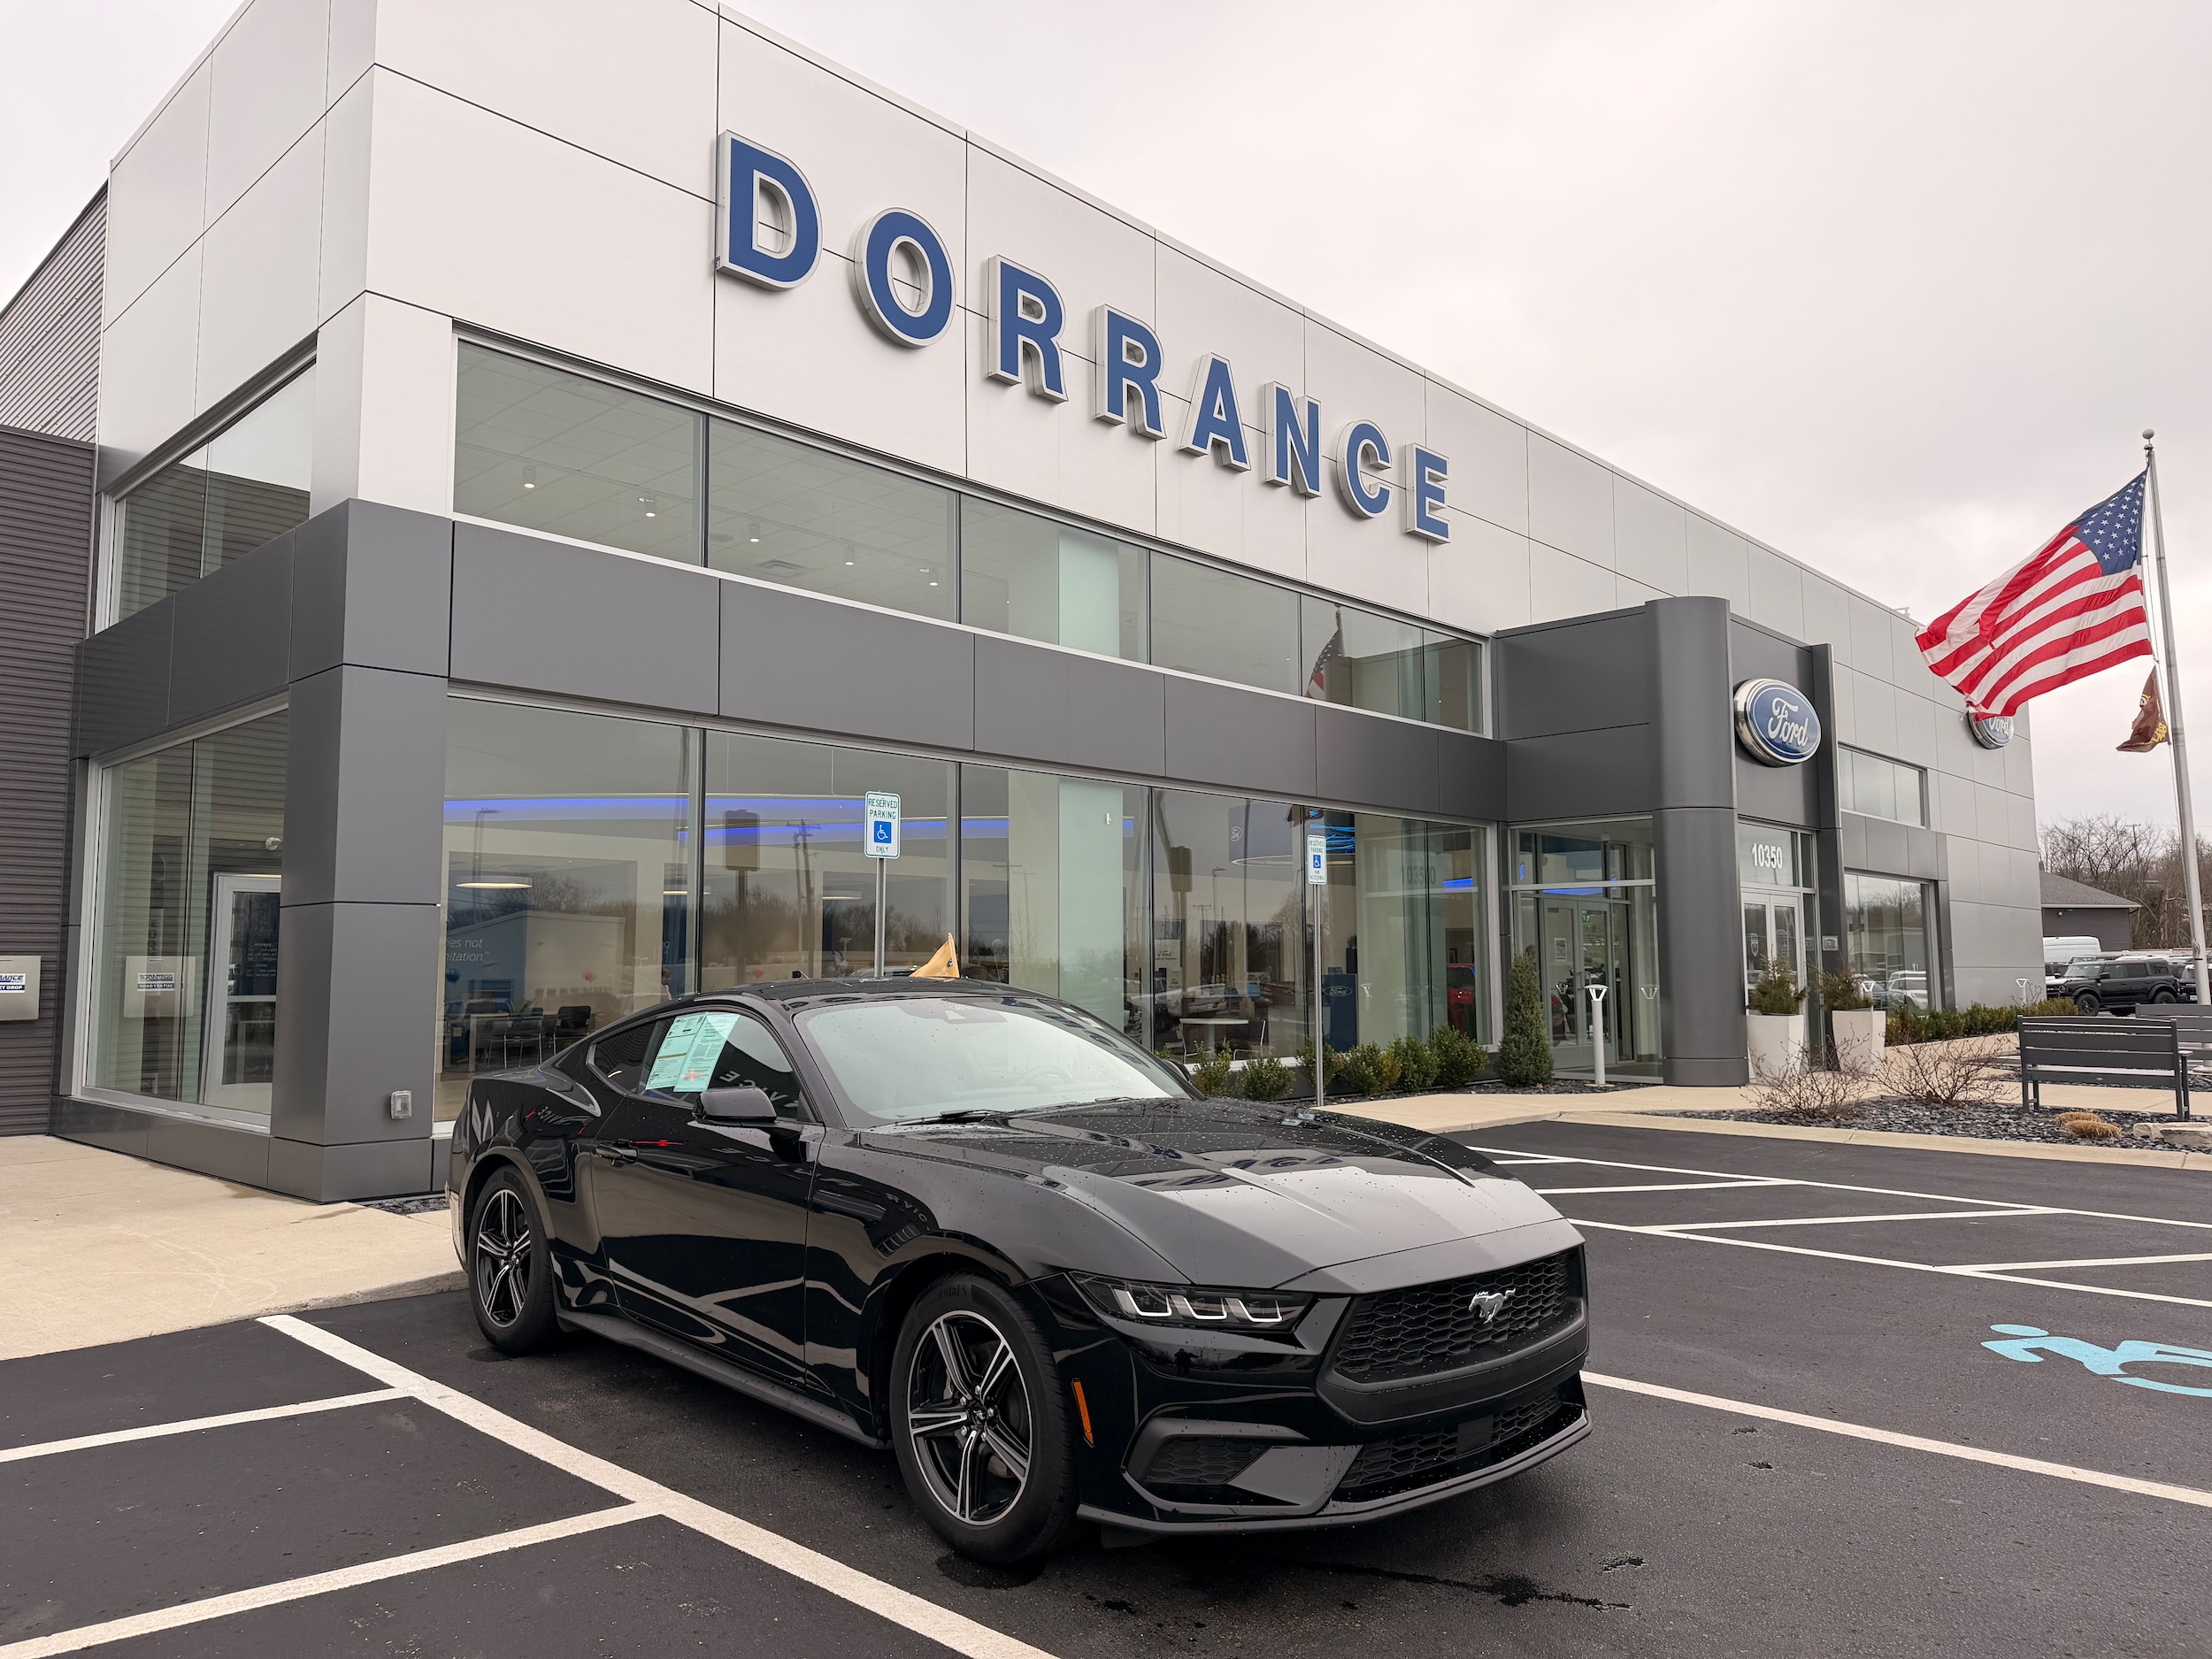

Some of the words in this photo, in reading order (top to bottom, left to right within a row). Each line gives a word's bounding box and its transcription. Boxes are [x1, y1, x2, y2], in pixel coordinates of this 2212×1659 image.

[717, 129, 1451, 544] DORRANCE
[1768, 697, 1809, 748] Ford
[868, 798, 898, 809] RESERVED
[869, 810, 896, 819] PARKING
[1752, 842, 1783, 870] 10350
[465, 939, 483, 949] not
[1328, 987, 1348, 996] Ford
